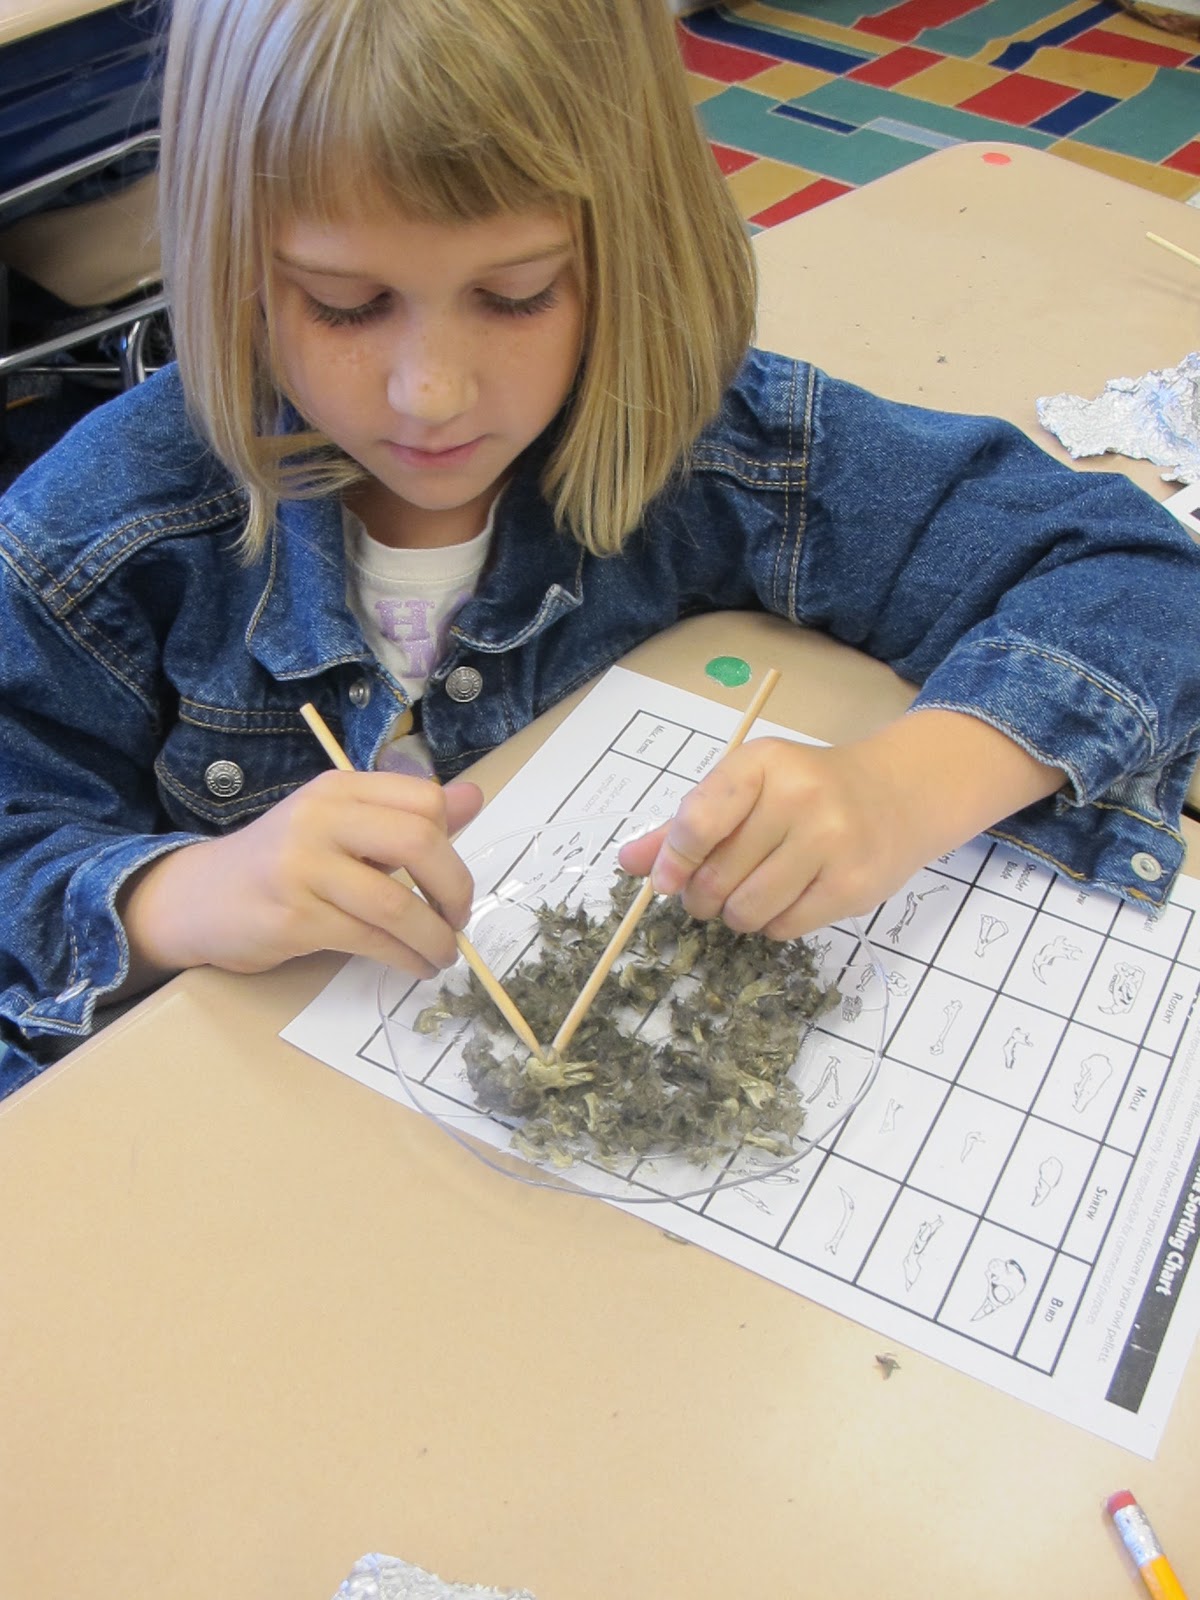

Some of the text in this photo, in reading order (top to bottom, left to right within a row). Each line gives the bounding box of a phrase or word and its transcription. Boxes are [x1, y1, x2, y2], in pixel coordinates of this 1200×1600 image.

[999, 860, 1019, 880] Blade
[1014, 862, 1037, 891] Shoulder
[1170, 1134, 1188, 1160] types
[1169, 1159, 1178, 1171] of
[1158, 1169, 1176, 1198] bones
[1151, 1198, 1166, 1218] that
[1141, 1217, 1157, 1236] you
[1166, 1192, 1199, 1250] Sorting
[1130, 1236, 1151, 1275] discover
[1126, 1275, 1138, 1286] in
[1154, 1249, 1185, 1297] Chart
[1114, 1285, 1133, 1309] your
[1110, 1309, 1125, 1329] owl
